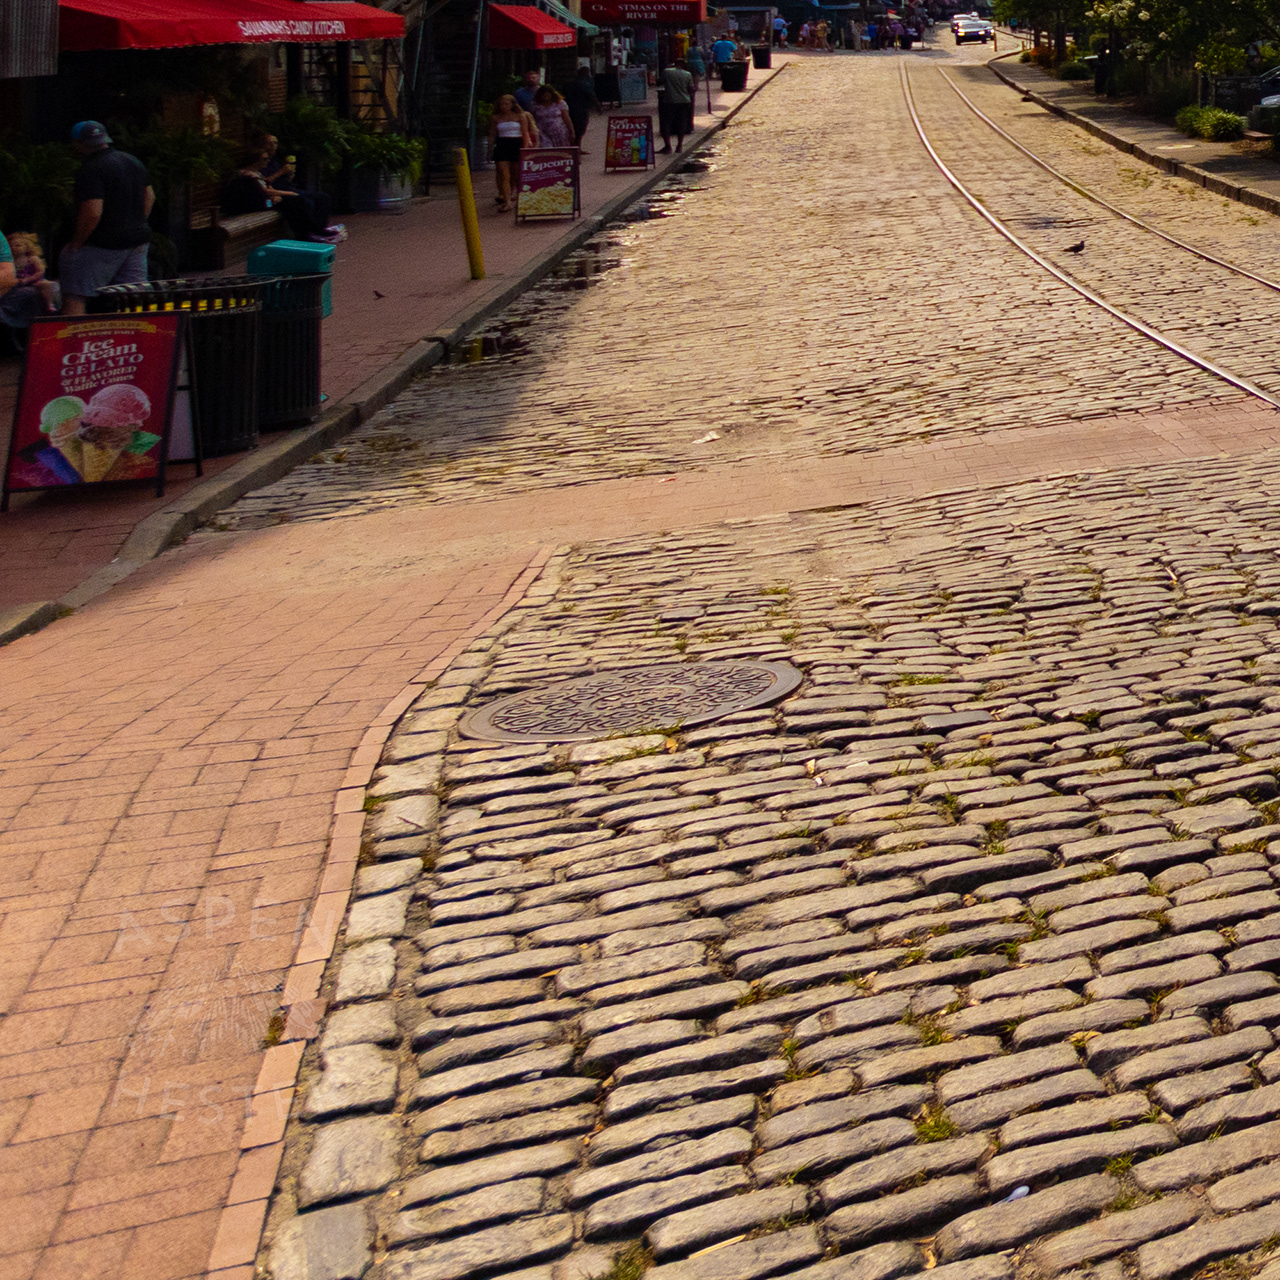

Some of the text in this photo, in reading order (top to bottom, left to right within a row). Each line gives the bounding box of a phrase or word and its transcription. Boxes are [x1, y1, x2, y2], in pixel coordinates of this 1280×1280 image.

[653, 4, 668, 12] ON
[670, 4, 690, 12] THE
[289, 20, 313, 35] CANDY
[315, 20, 347, 35] KITCHEN
[522, 159, 574, 172] Popcorn
[62, 342, 138, 366] Cream
[81, 338, 115, 354] Ice
[60, 353, 144, 377] GELATO
[61, 365, 137, 387] & FLAVORED
[63, 373, 135, 394] Waffle Cones
